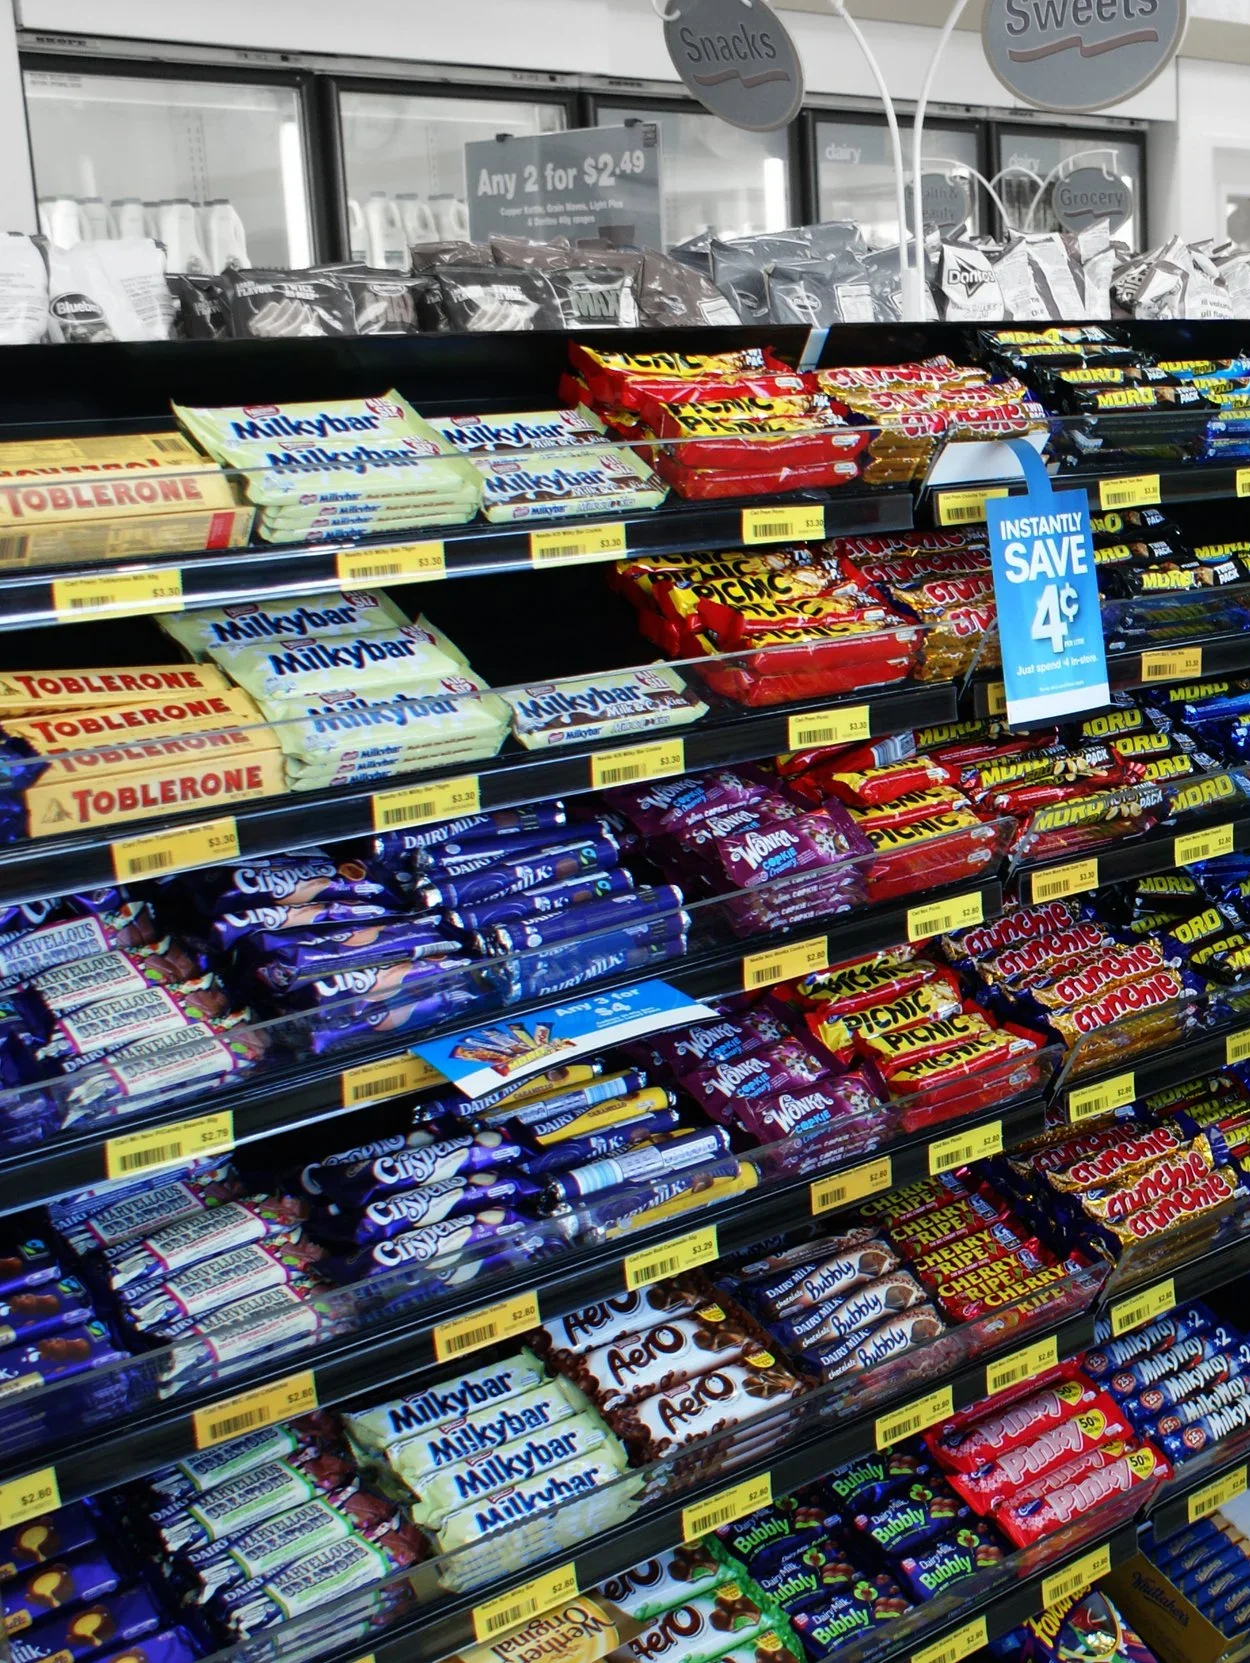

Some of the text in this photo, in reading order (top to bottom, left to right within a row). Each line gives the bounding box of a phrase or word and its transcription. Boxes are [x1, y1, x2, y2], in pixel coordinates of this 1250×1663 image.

[1006, 0, 1159, 36] Sweets
[680, 24, 777, 64] Snacks
[825, 143, 861, 163] dairy
[1008, 153, 1040, 173] dairy
[477, 150, 645, 199] Any 2 for $2.49
[1060, 188, 1123, 210] Grocery
[1096, 387, 1156, 409] MORO
[231, 412, 380, 440] Milkybar
[600, 538, 622, 548] $3.30
[1000, 512, 1082, 540] INSTANTLY
[418, 556, 442, 567] $3.30
[1004, 534, 1088, 584] SAVE
[152, 586, 180, 599] $3.30
[692, 572, 793, 605] PICNIC
[211, 604, 357, 643] Milkybar
[268, 635, 415, 677] Milkybar
[1016, 662, 1035, 676] Just
[1036, 659, 1061, 674] spend
[14, 671, 203, 699] TOBLERONE
[518, 683, 639, 719] Milkybar
[30, 697, 232, 744] TOBLERONE
[660, 755, 681, 766] $3.30
[1086, 747, 1110, 766] PACK
[72, 764, 263, 823] TOBLERONE
[452, 791, 475, 804] $3.30
[637, 778, 705, 810] WONKA
[208, 833, 235, 848] $3.30
[404, 822, 450, 850] DAIRY
[731, 828, 799, 871] WONKA
[866, 812, 960, 851] PICNIC
[962, 906, 980, 918] $2.80
[806, 951, 826, 963] $2.80
[70, 990, 162, 1027] MARVELLOUS
[555, 1000, 588, 1018] Any
[594, 993, 610, 1008] 3
[612, 987, 640, 1004] for
[599, 1001, 631, 1018] $4
[843, 989, 933, 1035] PICNIC
[676, 1022, 743, 1060] WONKA
[885, 1016, 971, 1053] PICNIC
[63, 1050, 108, 1073] DAIRY
[702, 1058, 771, 1099] WONKA
[763, 1093, 835, 1135] WONKA
[202, 1128, 228, 1142] $2.79
[983, 1134, 1001, 1146] $2.80
[869, 1170, 888, 1183] $2.80
[98, 1182, 184, 1227] MARVELLOUS
[890, 1200, 970, 1242] CHERRY
[892, 1190, 935, 1218] RIPE
[151, 1201, 238, 1245] MARVELLOUS
[919, 1215, 965, 1246] RIPE
[692, 1241, 713, 1255] $3.29
[916, 1229, 992, 1272] CHERRY
[942, 1243, 988, 1276] RIPE
[172, 1245, 259, 1288] MARVELLOUS
[766, 1263, 816, 1300] DAIRY MILK
[805, 1258, 857, 1303] Bubbly
[938, 1253, 1018, 1298] CHERRY
[775, 1290, 805, 1311] chocolate
[966, 1271, 1016, 1302] RIPE
[984, 1264, 1065, 1307] CHERRY
[512, 1306, 535, 1322] $2.80
[793, 1294, 846, 1338] DAIRY MILK
[831, 1291, 883, 1338] Bubbly
[820, 1327, 871, 1367] DAIRY MILK
[828, 1358, 858, 1381] chocolate
[288, 1387, 314, 1403] $2.80
[388, 1372, 514, 1435] Milkybar
[428, 1400, 550, 1466] Milkybar
[977, 1389, 1062, 1447] Pinky
[453, 1431, 578, 1500] Milkybar
[997, 1420, 1084, 1485] Pinky
[200, 1463, 283, 1509] MARVELLOUS
[1044, 1456, 1133, 1523] Pinky
[238, 1503, 323, 1551] MARVELLOUS
[870, 1498, 909, 1526] Dairy Milk
[871, 1506, 926, 1548] Bubbly
[734, 1516, 791, 1556] Bubbly
[273, 1537, 359, 1588] MARVELLOUS
[919, 1544, 957, 1571] Dairy Milk
[919, 1552, 973, 1592] Bubbly
[223, 1576, 265, 1603] DAIRY
[491, 1607, 589, 1661] Original
[812, 1607, 835, 1625] Dairy
